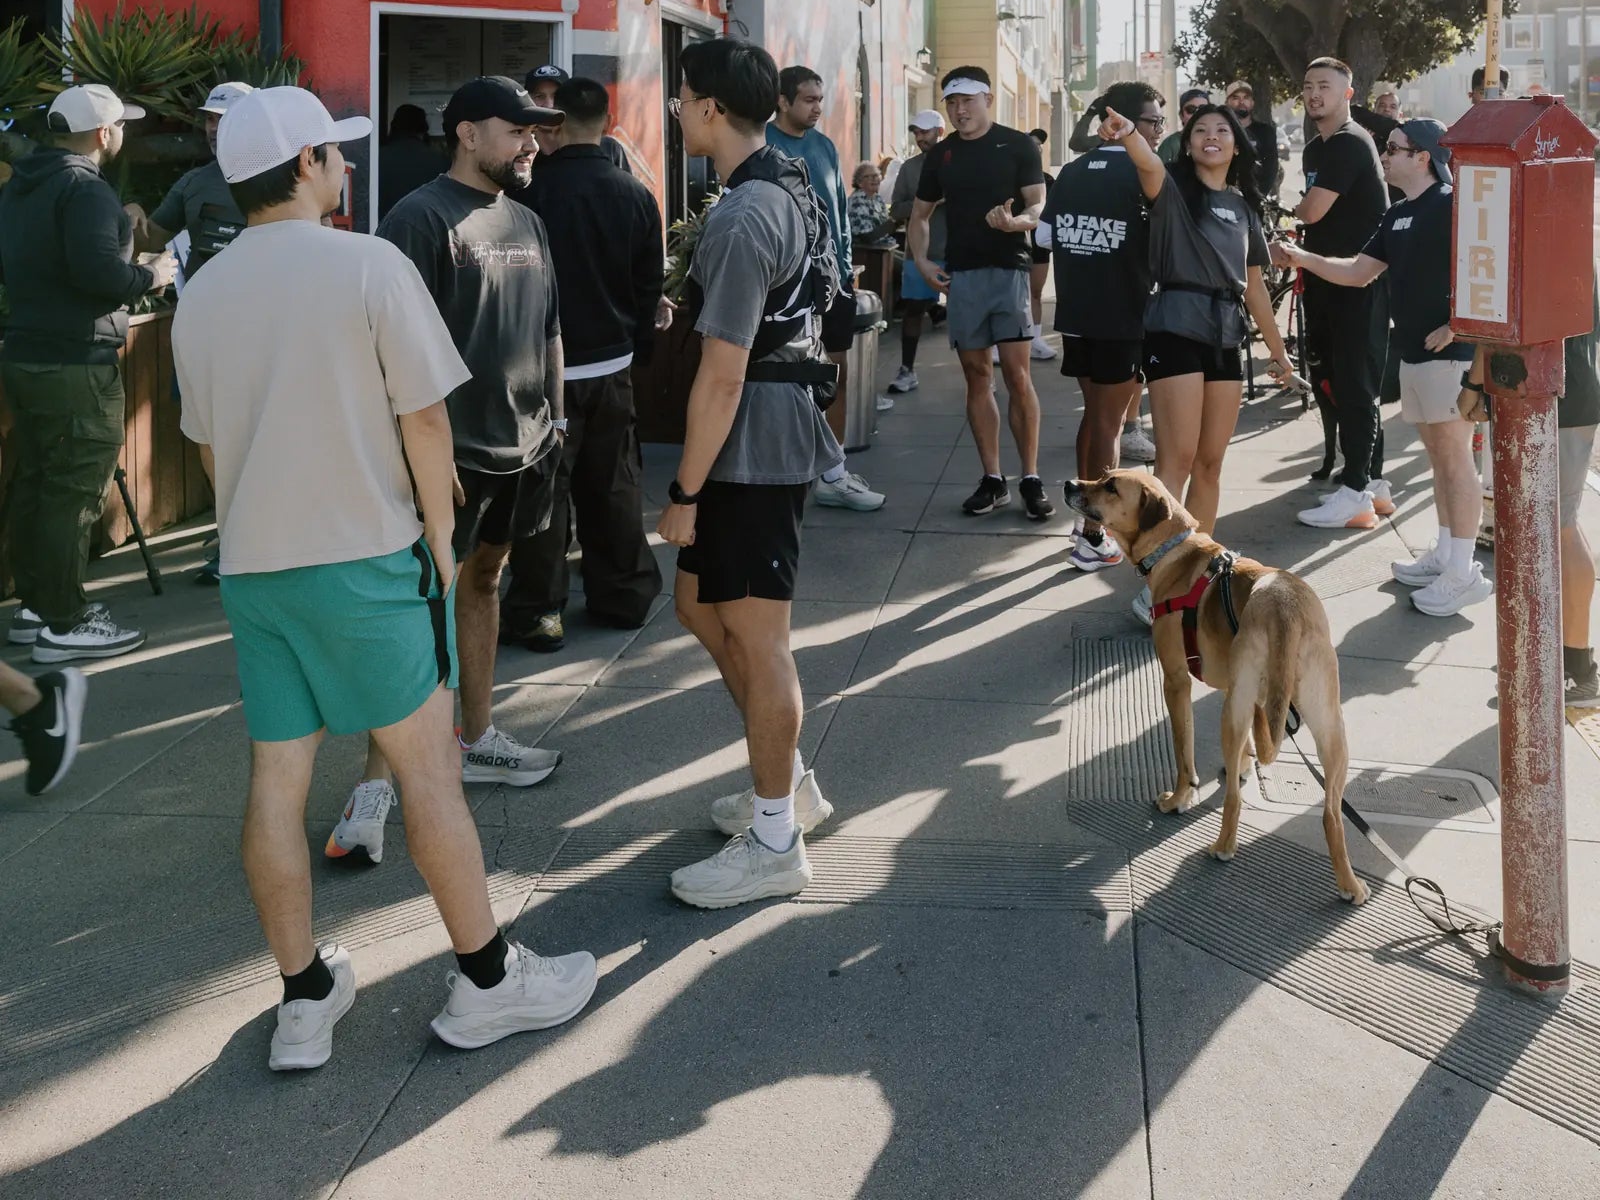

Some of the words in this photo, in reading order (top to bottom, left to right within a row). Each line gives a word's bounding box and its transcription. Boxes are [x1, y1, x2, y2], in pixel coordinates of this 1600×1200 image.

[1491, 13, 1500, 46] STOP
[1056, 213, 1075, 228] NO
[1077, 215, 1127, 236] FAKE
[1057, 227, 1126, 249] SWEAT
[1468, 170, 1497, 318] FIRE
[466, 752, 522, 769] BROOKS
